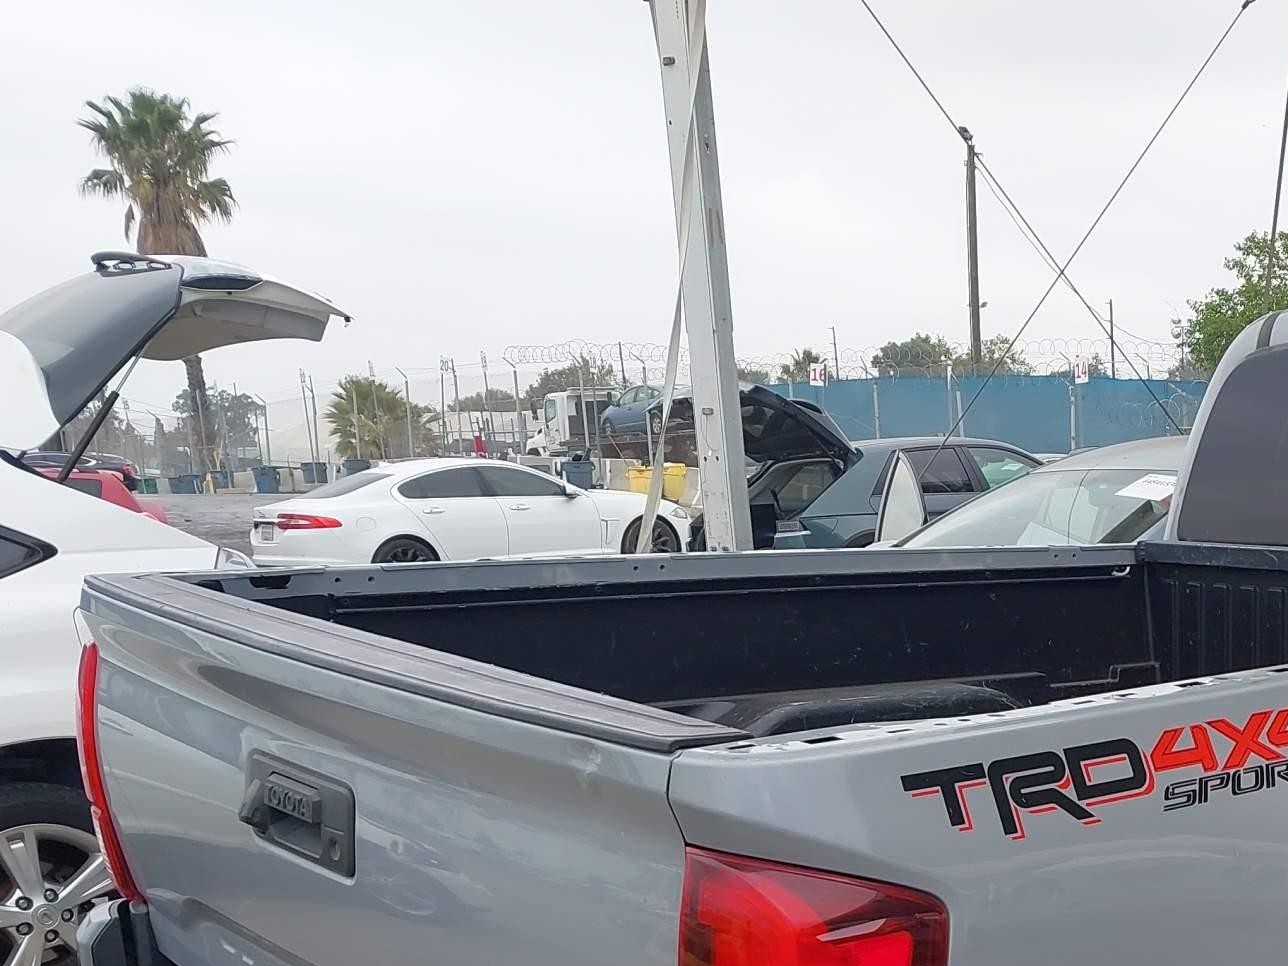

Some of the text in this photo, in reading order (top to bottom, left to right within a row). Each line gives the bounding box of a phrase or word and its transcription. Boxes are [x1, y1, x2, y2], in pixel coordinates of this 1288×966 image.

[1075, 361, 1087, 379] 14
[264, 783, 313, 820] TOYOTA
[900, 737, 1156, 840] TRD
